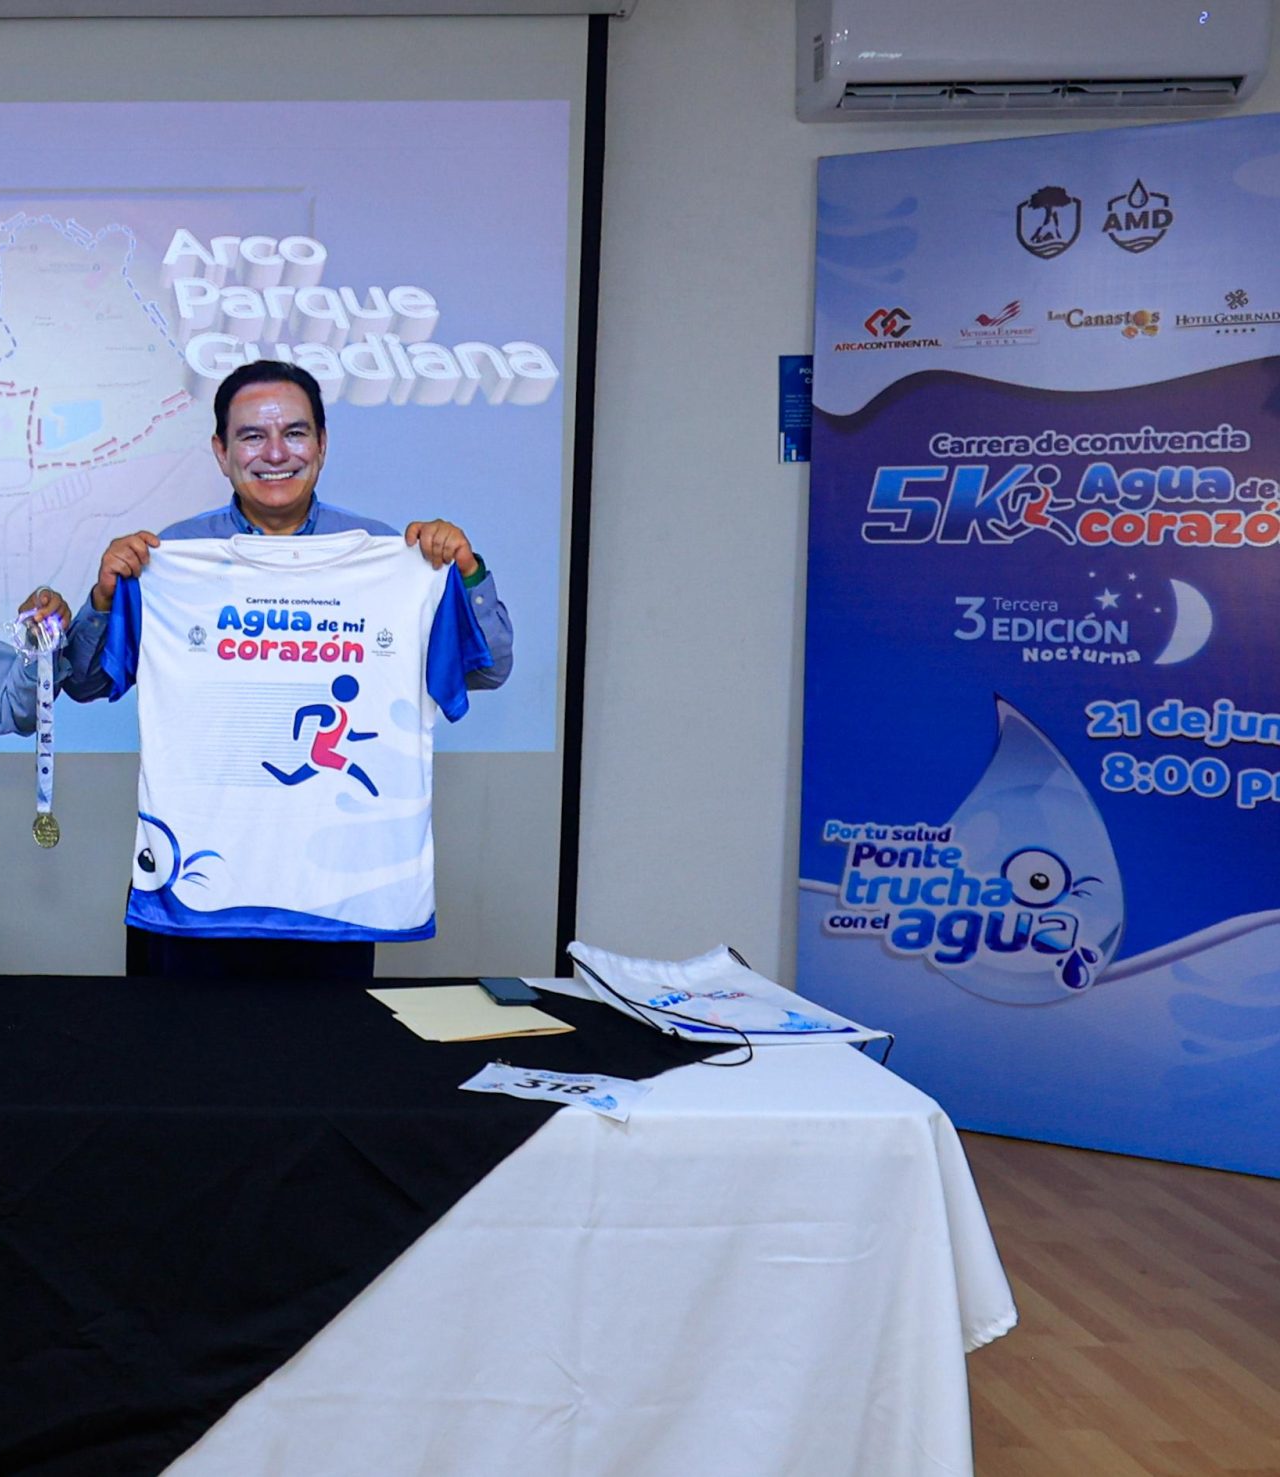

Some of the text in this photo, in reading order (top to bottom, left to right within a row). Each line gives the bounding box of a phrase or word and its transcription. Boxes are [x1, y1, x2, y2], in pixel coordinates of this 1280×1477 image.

[1102, 208, 1173, 233] AMD
[162, 228, 327, 271] Arco
[173, 278, 438, 333] Parque
[1066, 307, 1160, 330] Canastos
[835, 339, 942, 351] ARCACONTINENTAL
[930, 424, 1250, 457] Carrera de convivencia
[1078, 462, 1278, 511] Agua de
[862, 464, 1033, 544] 5K
[1077, 500, 1280, 548] corazó
[279, 597, 289, 605] de
[291, 598, 340, 606] convivencia
[993, 597, 1059, 613] Tercera
[217, 605, 364, 637] Agua de mi
[954, 597, 986, 640] 3
[992, 613, 1129, 643] EDICIÓN
[217, 634, 364, 663] corazón
[1023, 647, 1141, 665] Nocturna
[1085, 701, 1141, 738] 21
[1147, 699, 1209, 738] de
[1102, 753, 1280, 809] 8:00 p
[825, 822, 952, 843] Por tu salud
[852, 842, 963, 869] Ponte
[844, 868, 1014, 907] trucha
[829, 910, 1079, 965] con el agua
[514, 1078, 596, 1095] 318
